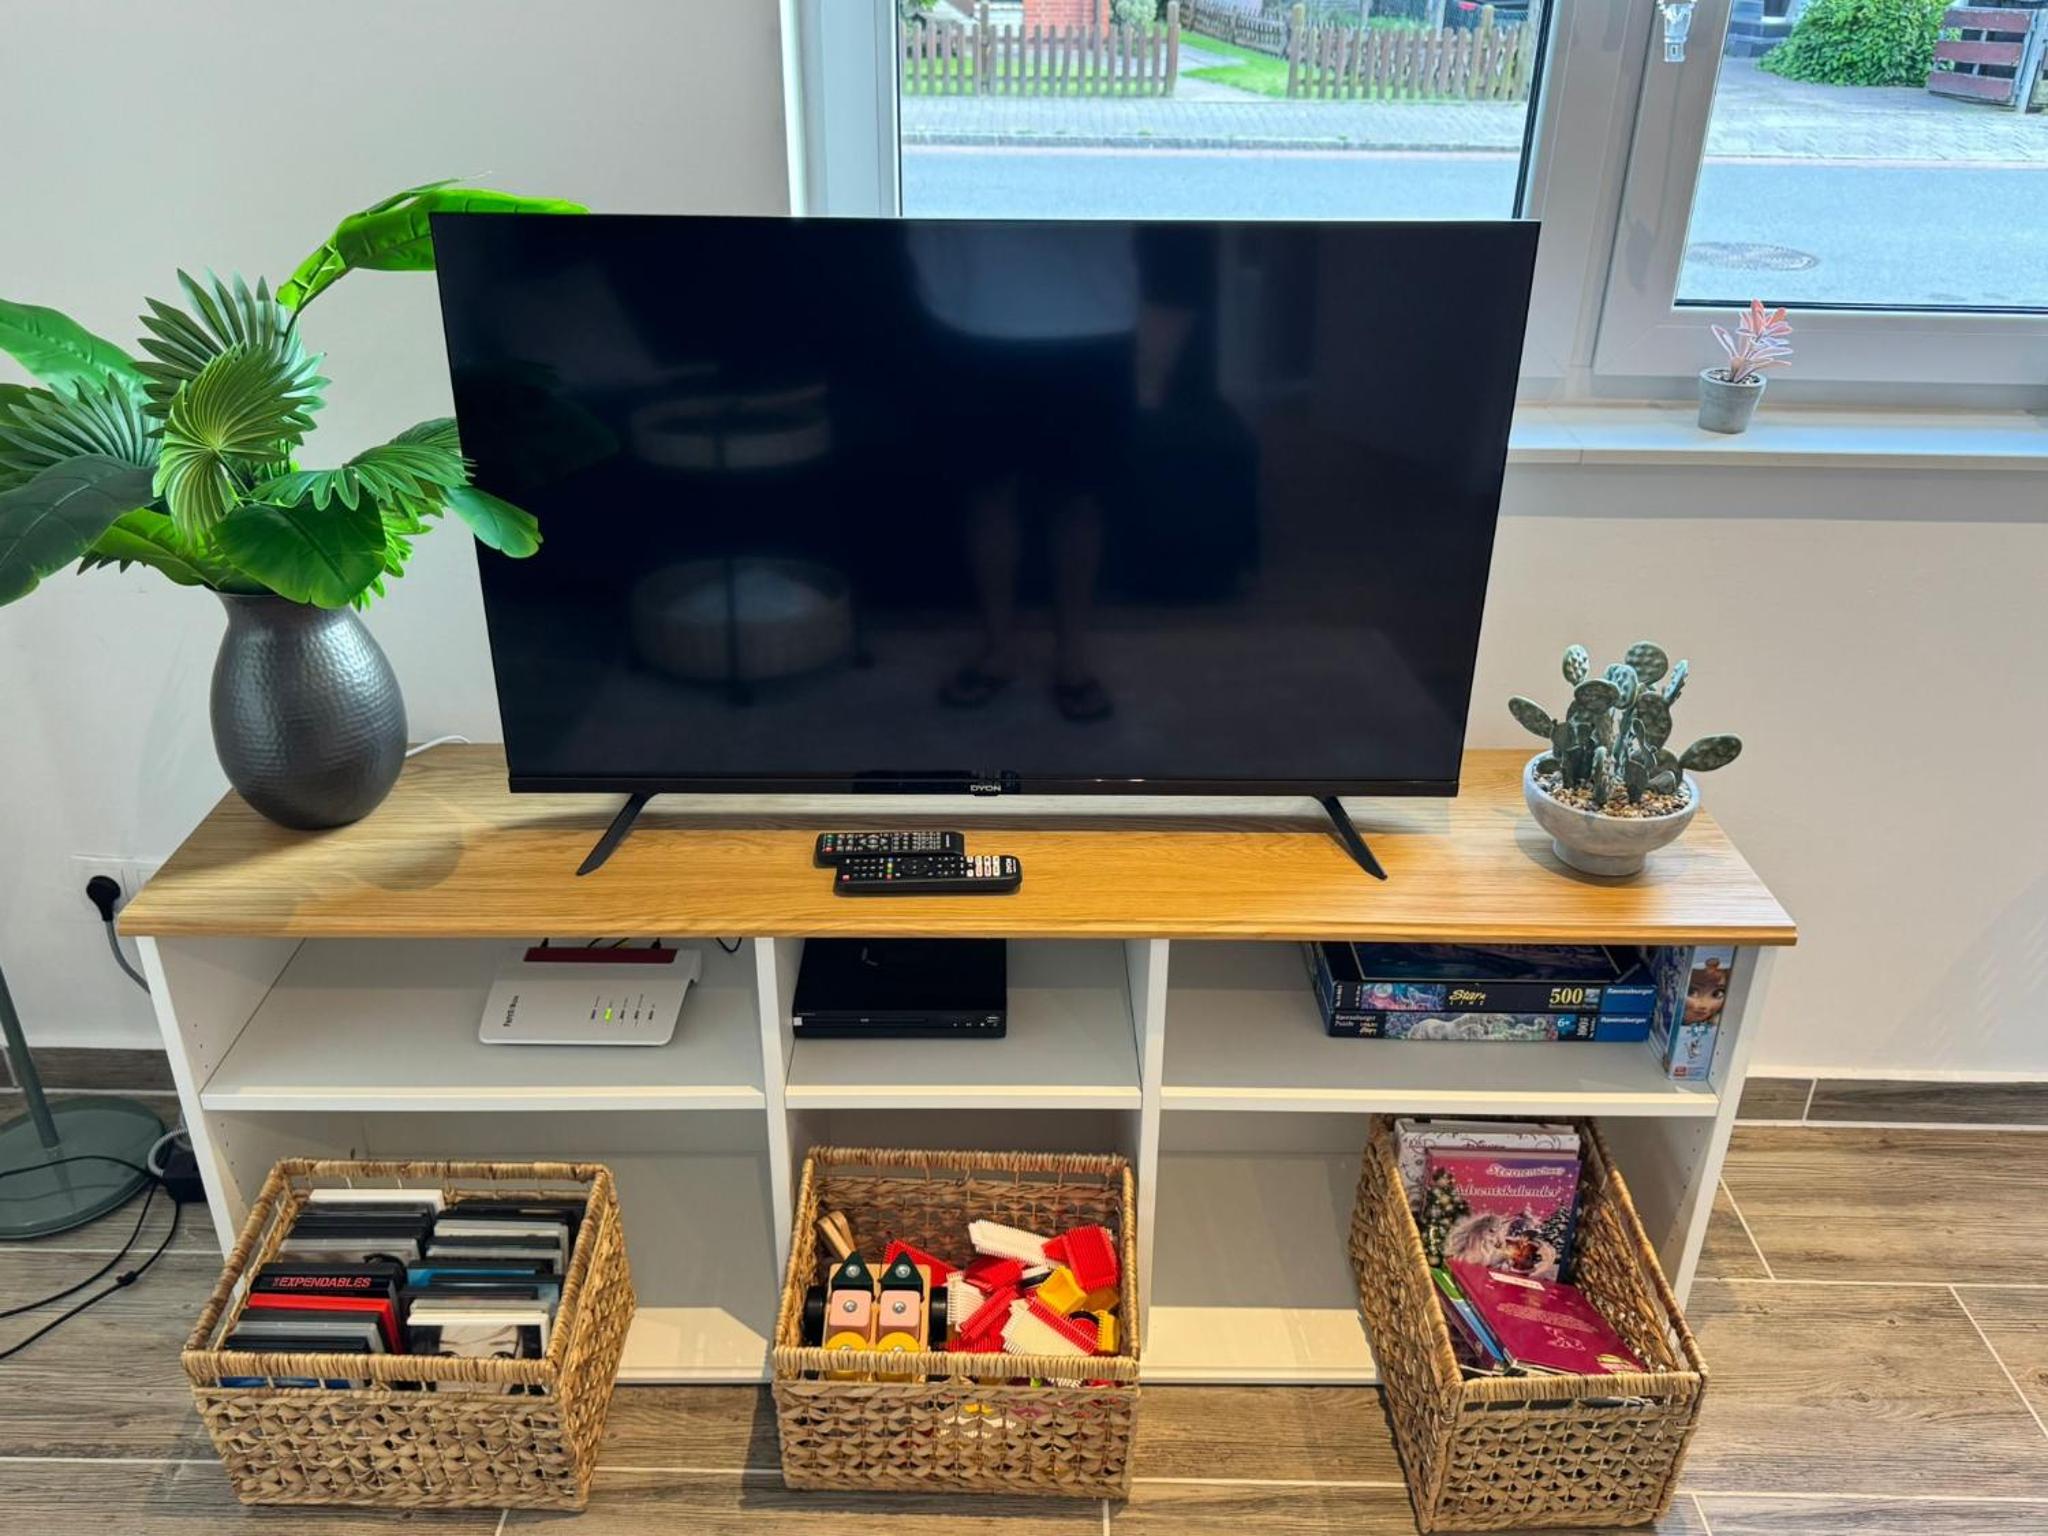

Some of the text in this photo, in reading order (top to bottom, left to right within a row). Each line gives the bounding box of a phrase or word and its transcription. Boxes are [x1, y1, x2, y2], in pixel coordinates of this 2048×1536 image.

[970, 784, 1001, 792] DYON
[1549, 988, 1583, 1004] 500
[279, 1277, 371, 1287] EXPENDABLES
